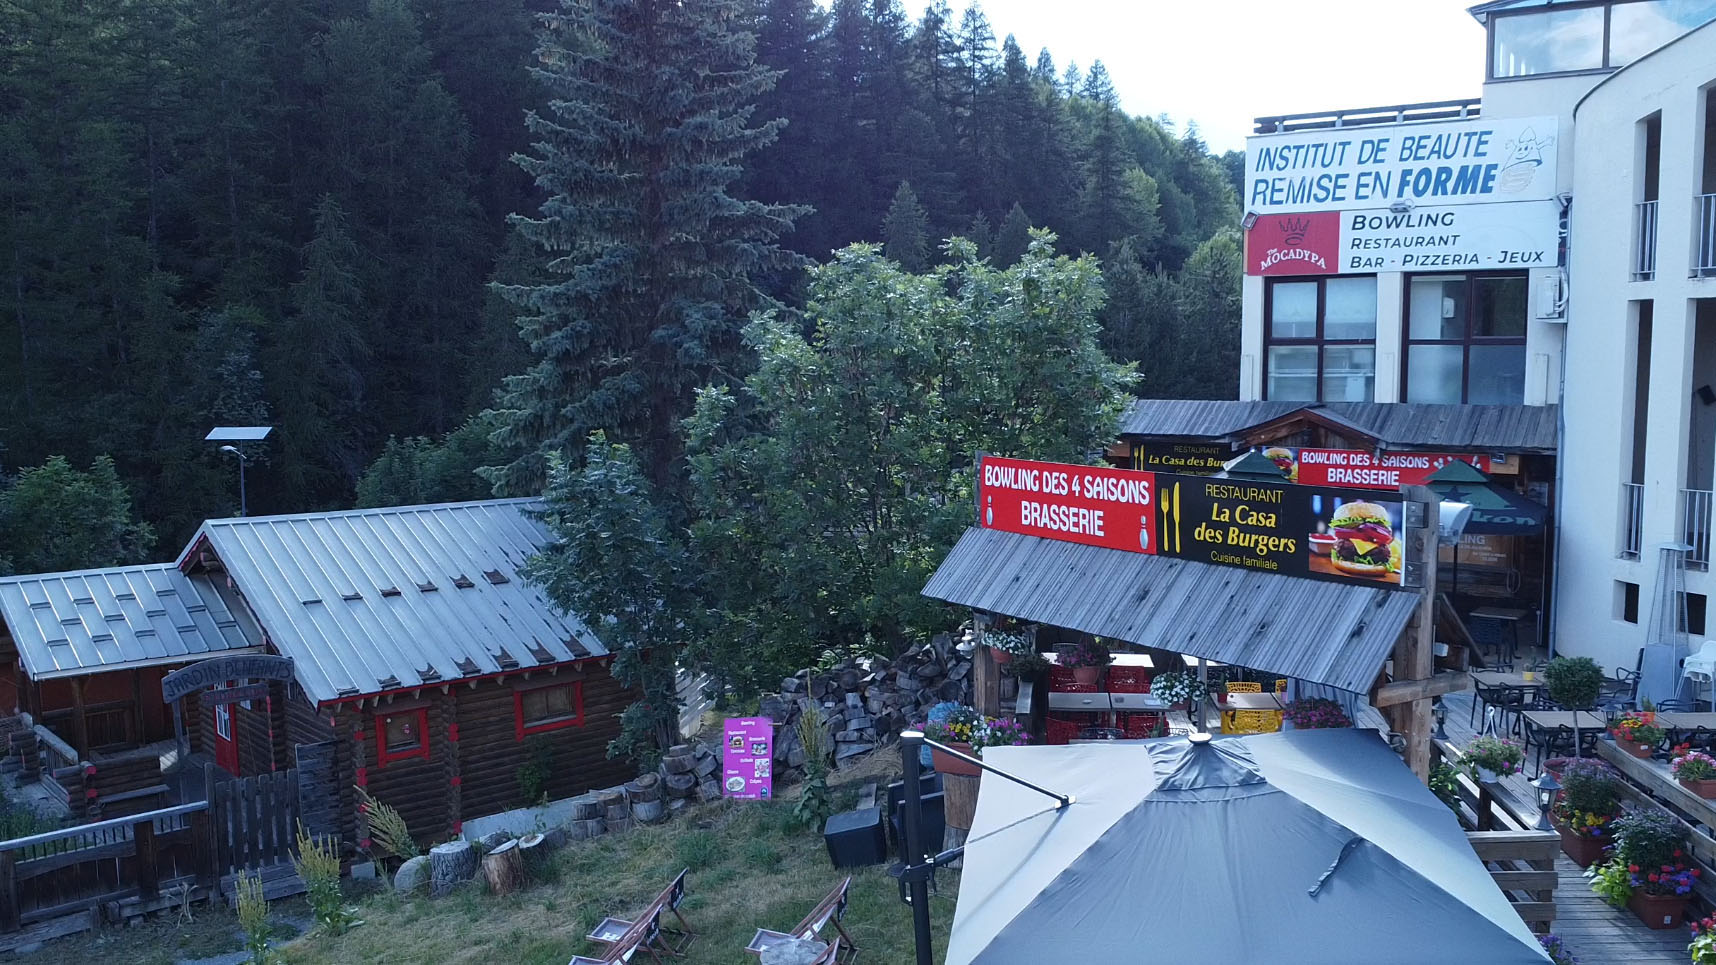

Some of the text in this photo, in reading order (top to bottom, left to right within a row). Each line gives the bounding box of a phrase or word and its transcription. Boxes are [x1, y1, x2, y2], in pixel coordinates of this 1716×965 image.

[1255, 130, 1493, 172] INSTITUT DE BEAUTE
[1251, 163, 1499, 206] REMISE EN FORME
[1351, 212, 1455, 231] BOWLING
[1350, 234, 1461, 250] RESTAURANT
[1260, 248, 1327, 271] MOCADYPA
[1350, 256, 1385, 269] BAR
[1402, 253, 1480, 267] PIZZERIA
[1497, 250, 1545, 264] JEUX
[1149, 454, 1159, 464] La
[1162, 455, 1185, 466] Casa
[1186, 455, 1204, 467] des
[1173, 445, 1220, 455] RESTAURANT
[1301, 452, 1429, 469] BOWLING DES 4 SAISONS
[985, 465, 1150, 505] BOWLING DES 4 SAISONS
[1327, 467, 1399, 486] BRASSERIE
[1205, 483, 1283, 504] RESTAURANT
[1021, 500, 1105, 537] BRASSERIE
[1211, 502, 1277, 528] La Casa
[1194, 522, 1296, 556] des Burgers
[1210, 550, 1279, 571] Cuisine familiale
[164, 663, 220, 698] JARDIN
